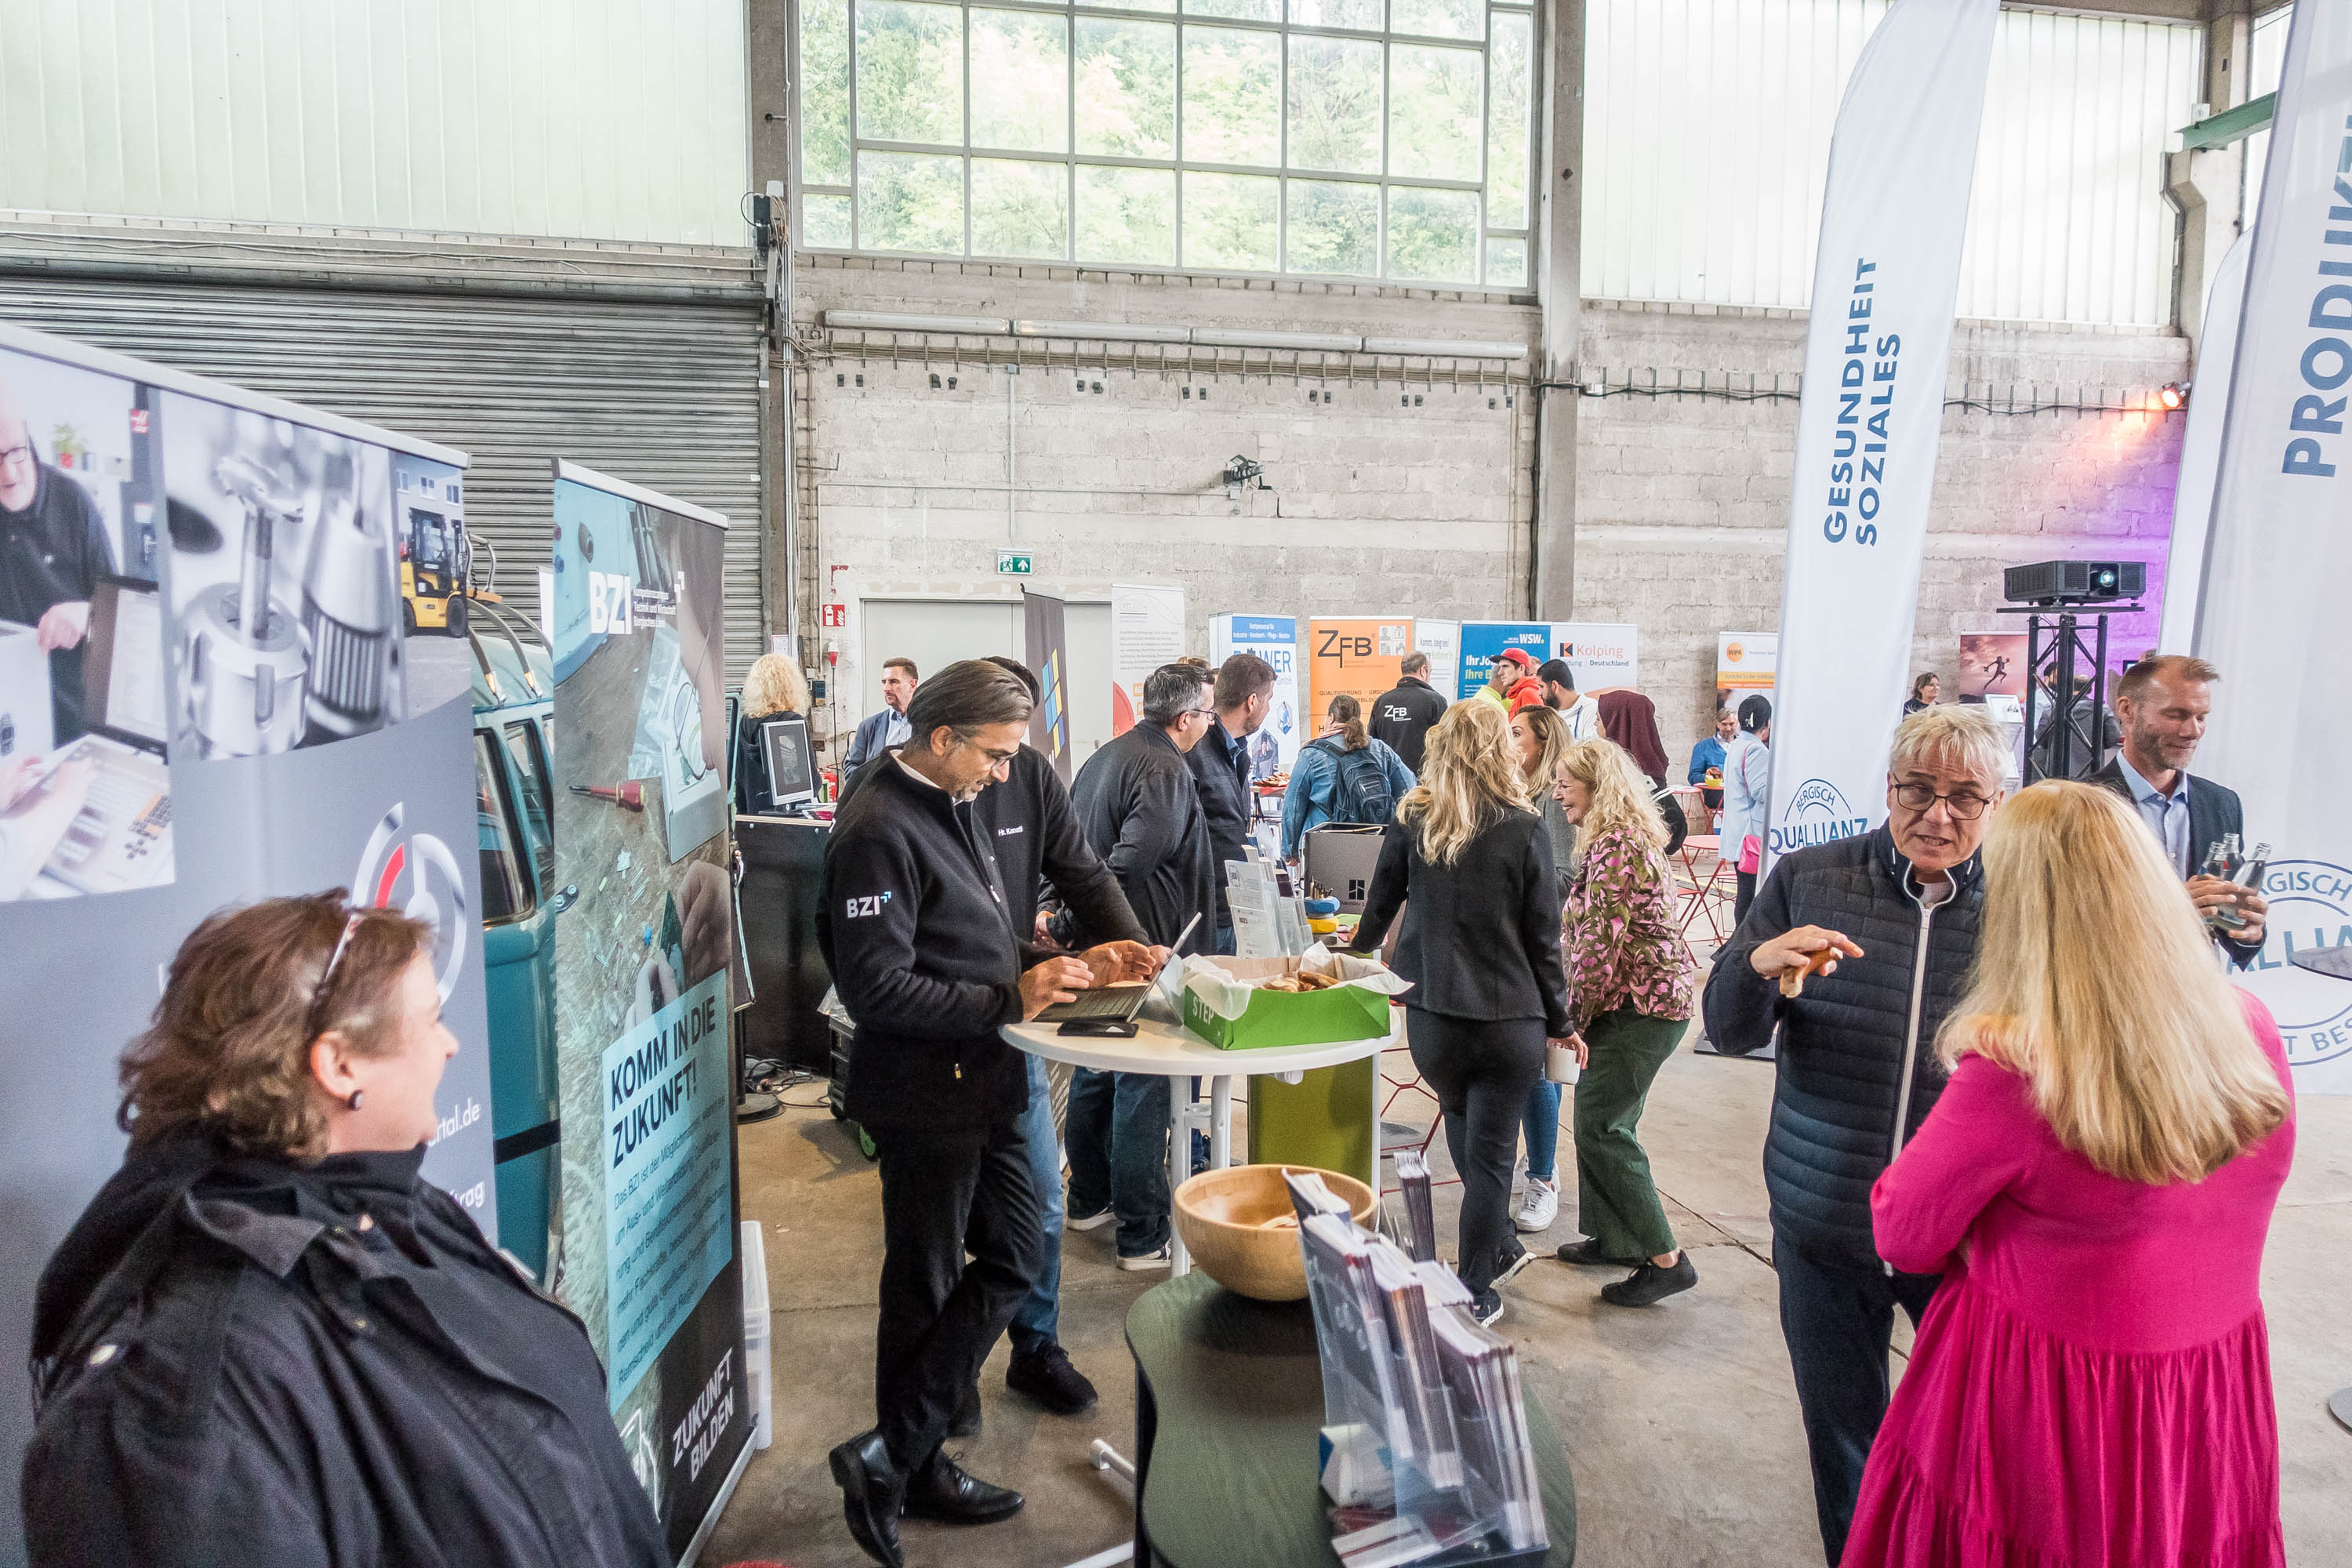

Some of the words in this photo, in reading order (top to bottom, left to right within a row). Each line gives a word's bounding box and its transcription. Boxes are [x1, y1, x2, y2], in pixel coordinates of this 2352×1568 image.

[1824, 257, 1878, 543] GESUNDHEIT
[1856, 333, 1901, 546] SOZIALES
[590, 571, 632, 634] BZI
[1317, 630, 1373, 668] ZFB
[1465, 655, 1479, 666] Ihr
[1577, 645, 1624, 659] Kolping
[1465, 669, 1483, 680] Ihre
[1384, 705, 1408, 721] ZFB
[1796, 786, 1835, 813] BERGISCH
[847, 895, 880, 918] BZI
[611, 1029, 668, 1112] KOMM
[673, 1014, 688, 1060] IN
[691, 994, 716, 1046] DIE
[428, 1098, 481, 1147] rtal.de
[612, 1057, 697, 1170] ZUKUNFT!
[614, 1185, 626, 1209] Das
[628, 1173, 639, 1193] BZI
[649, 1153, 659, 1173] der
[615, 1227, 624, 1245] um
[626, 1207, 641, 1232] Aus-
[642, 1196, 653, 1214] und
[631, 1241, 644, 1260] und
[631, 1313, 643, 1332] und
[619, 1334, 653, 1384] Remscheid
[673, 1347, 732, 1468] ZUKUNFT
[691, 1386, 734, 1483] BILDEN
